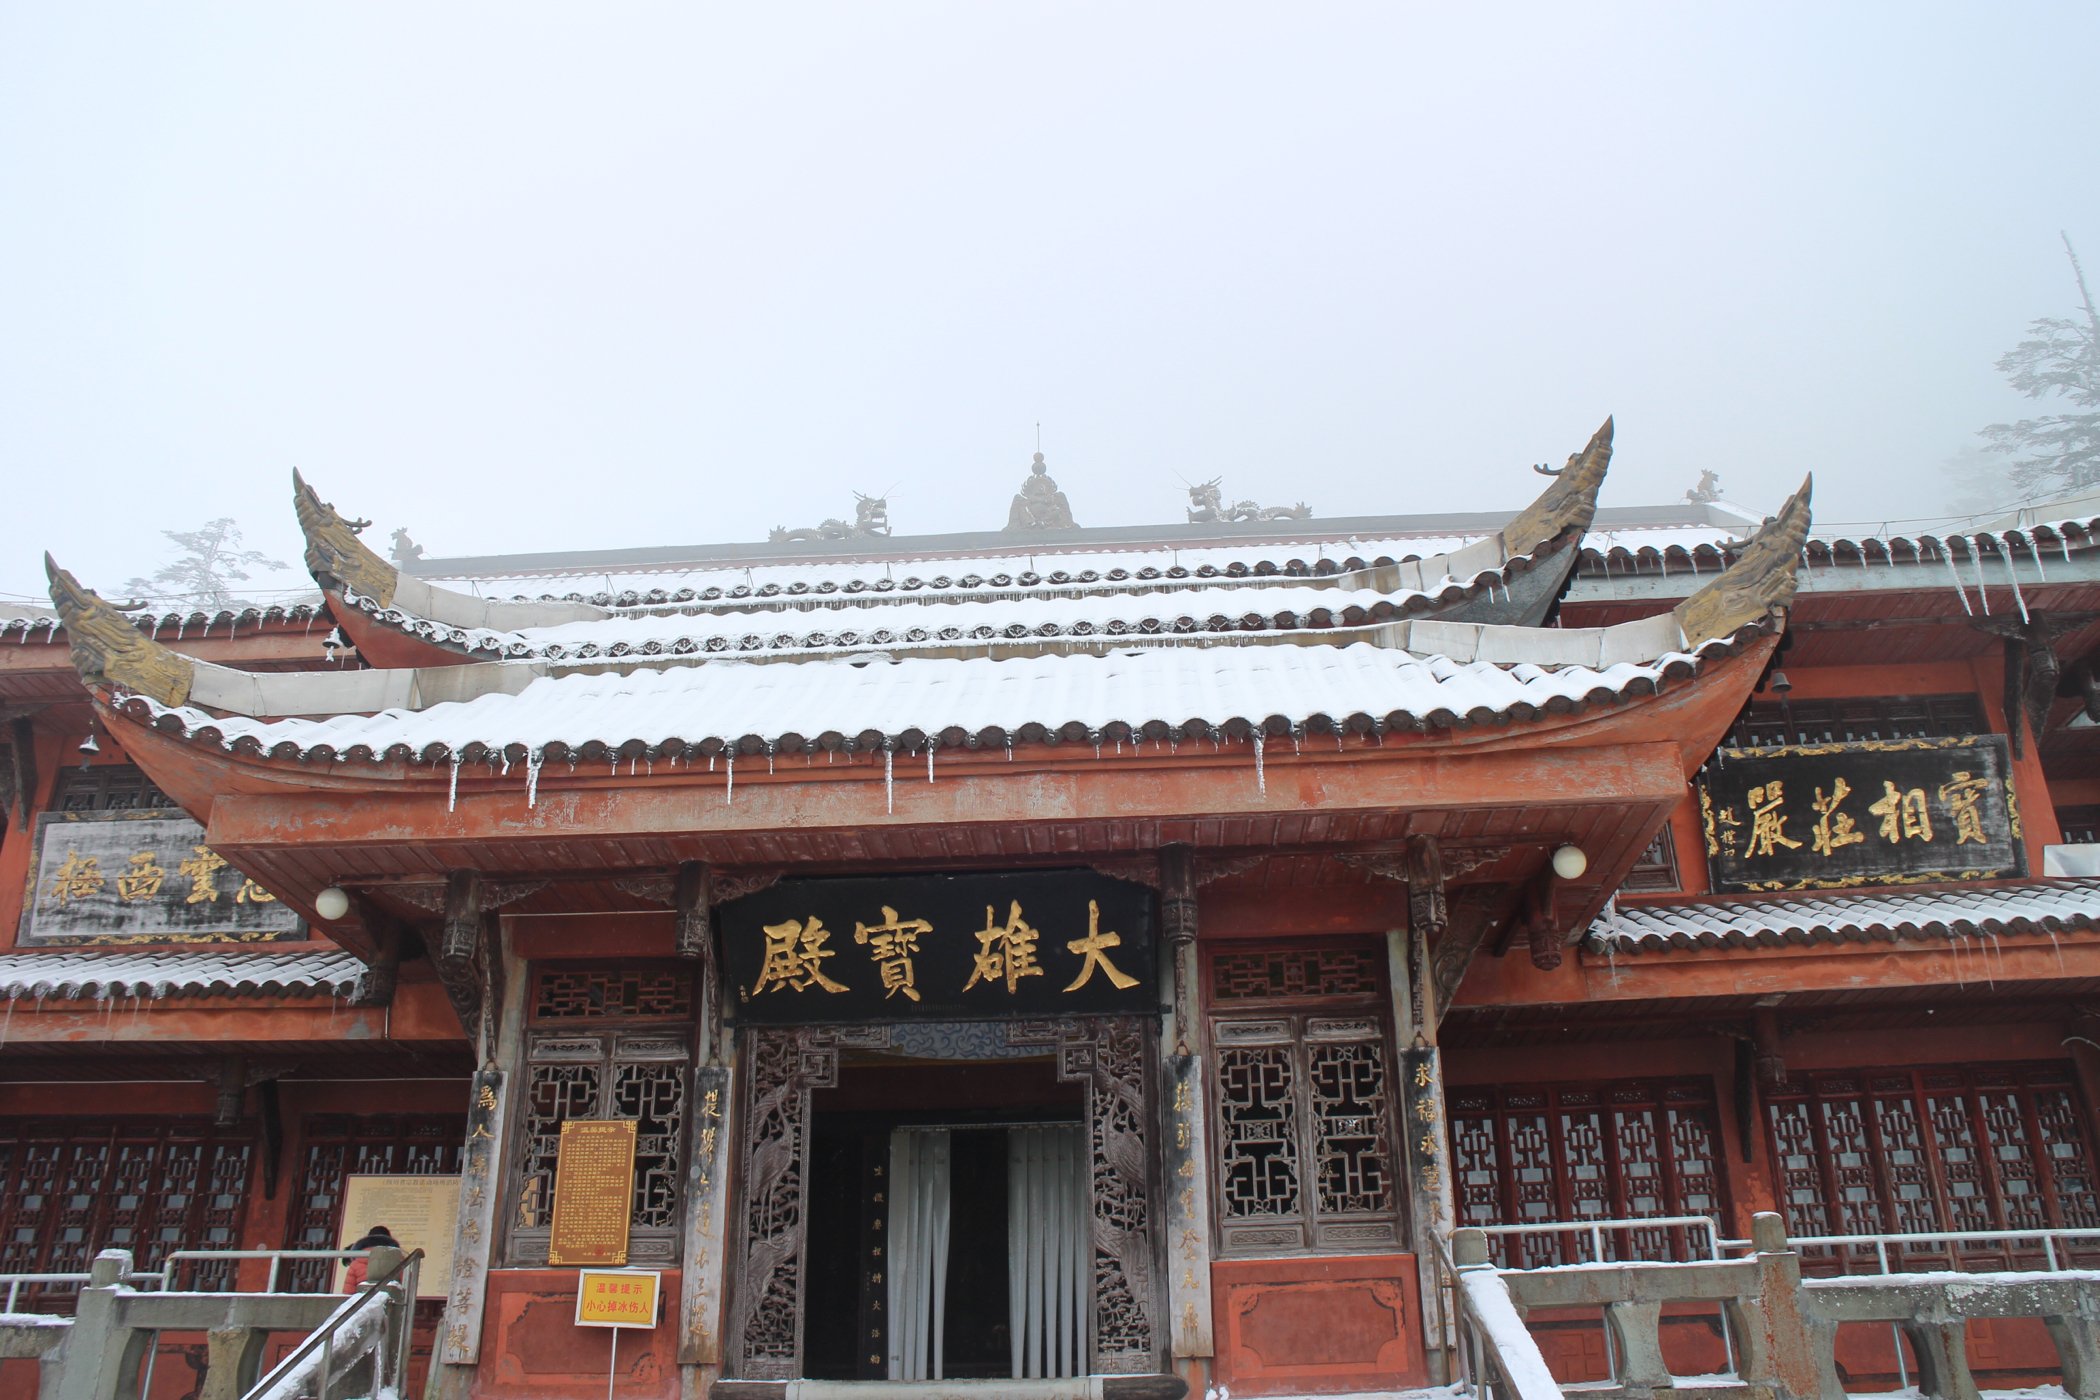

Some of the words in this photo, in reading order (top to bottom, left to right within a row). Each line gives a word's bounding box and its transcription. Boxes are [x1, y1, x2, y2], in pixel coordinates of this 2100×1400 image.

[752, 899, 1141, 1002] 大雄寶殿
[596, 1282, 643, 1294] 温馨提示
[586, 1300, 648, 1313] 小心掉冰伤人
